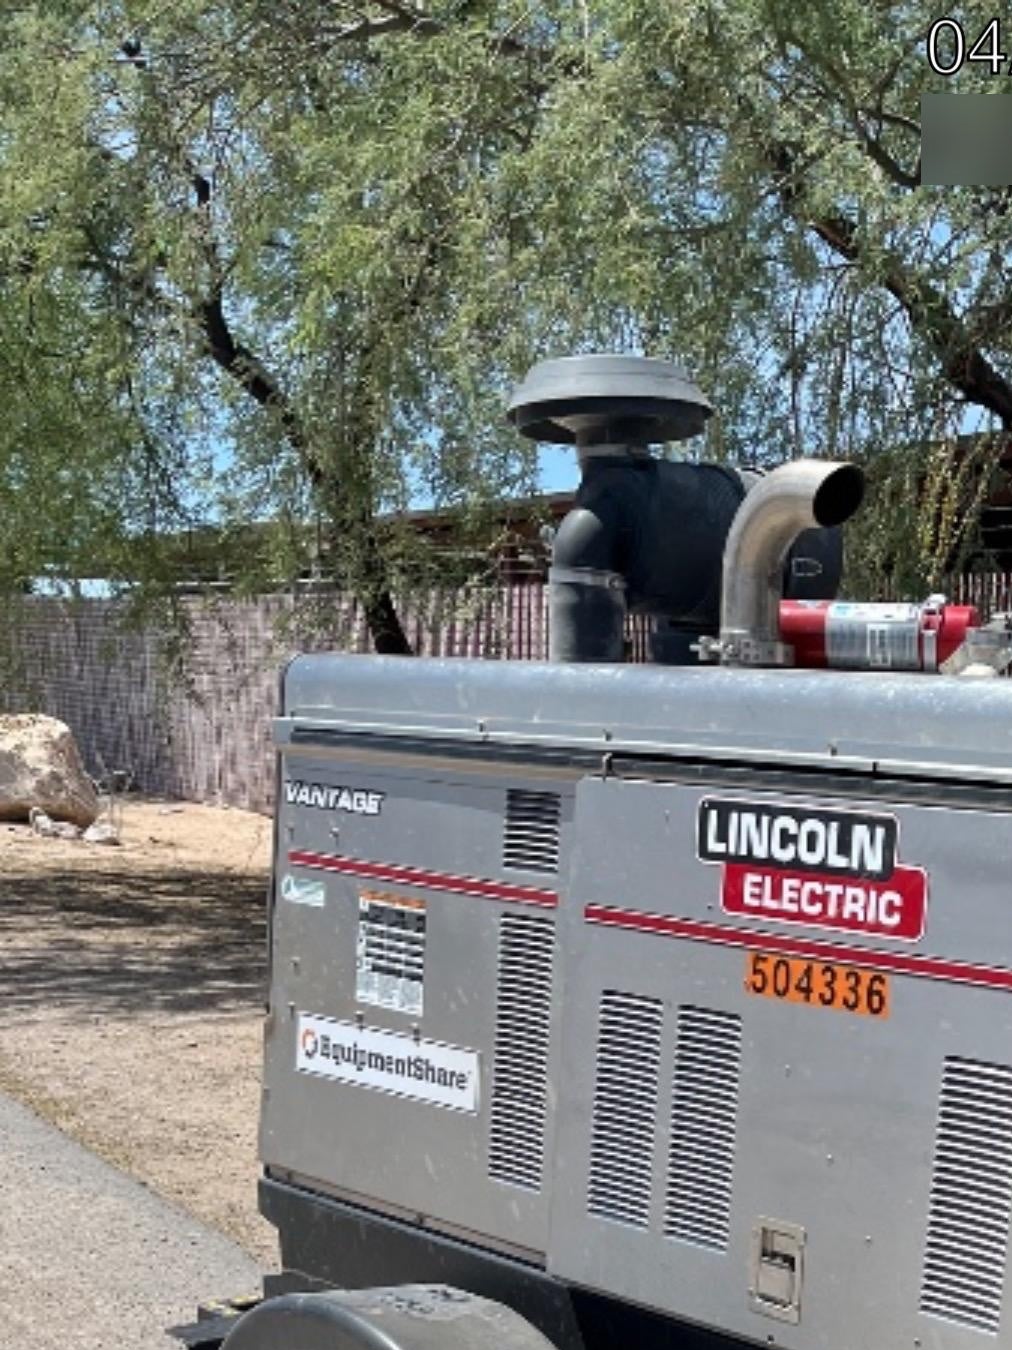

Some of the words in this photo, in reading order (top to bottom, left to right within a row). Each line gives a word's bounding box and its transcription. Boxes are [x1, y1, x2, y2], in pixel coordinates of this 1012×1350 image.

[285, 781, 384, 815] VANTAGE
[707, 809, 886, 873] LINCOLN
[743, 872, 904, 927] ELECTRIC
[751, 954, 887, 1016] 504336
[318, 1034, 470, 1091] EquipmentShare
